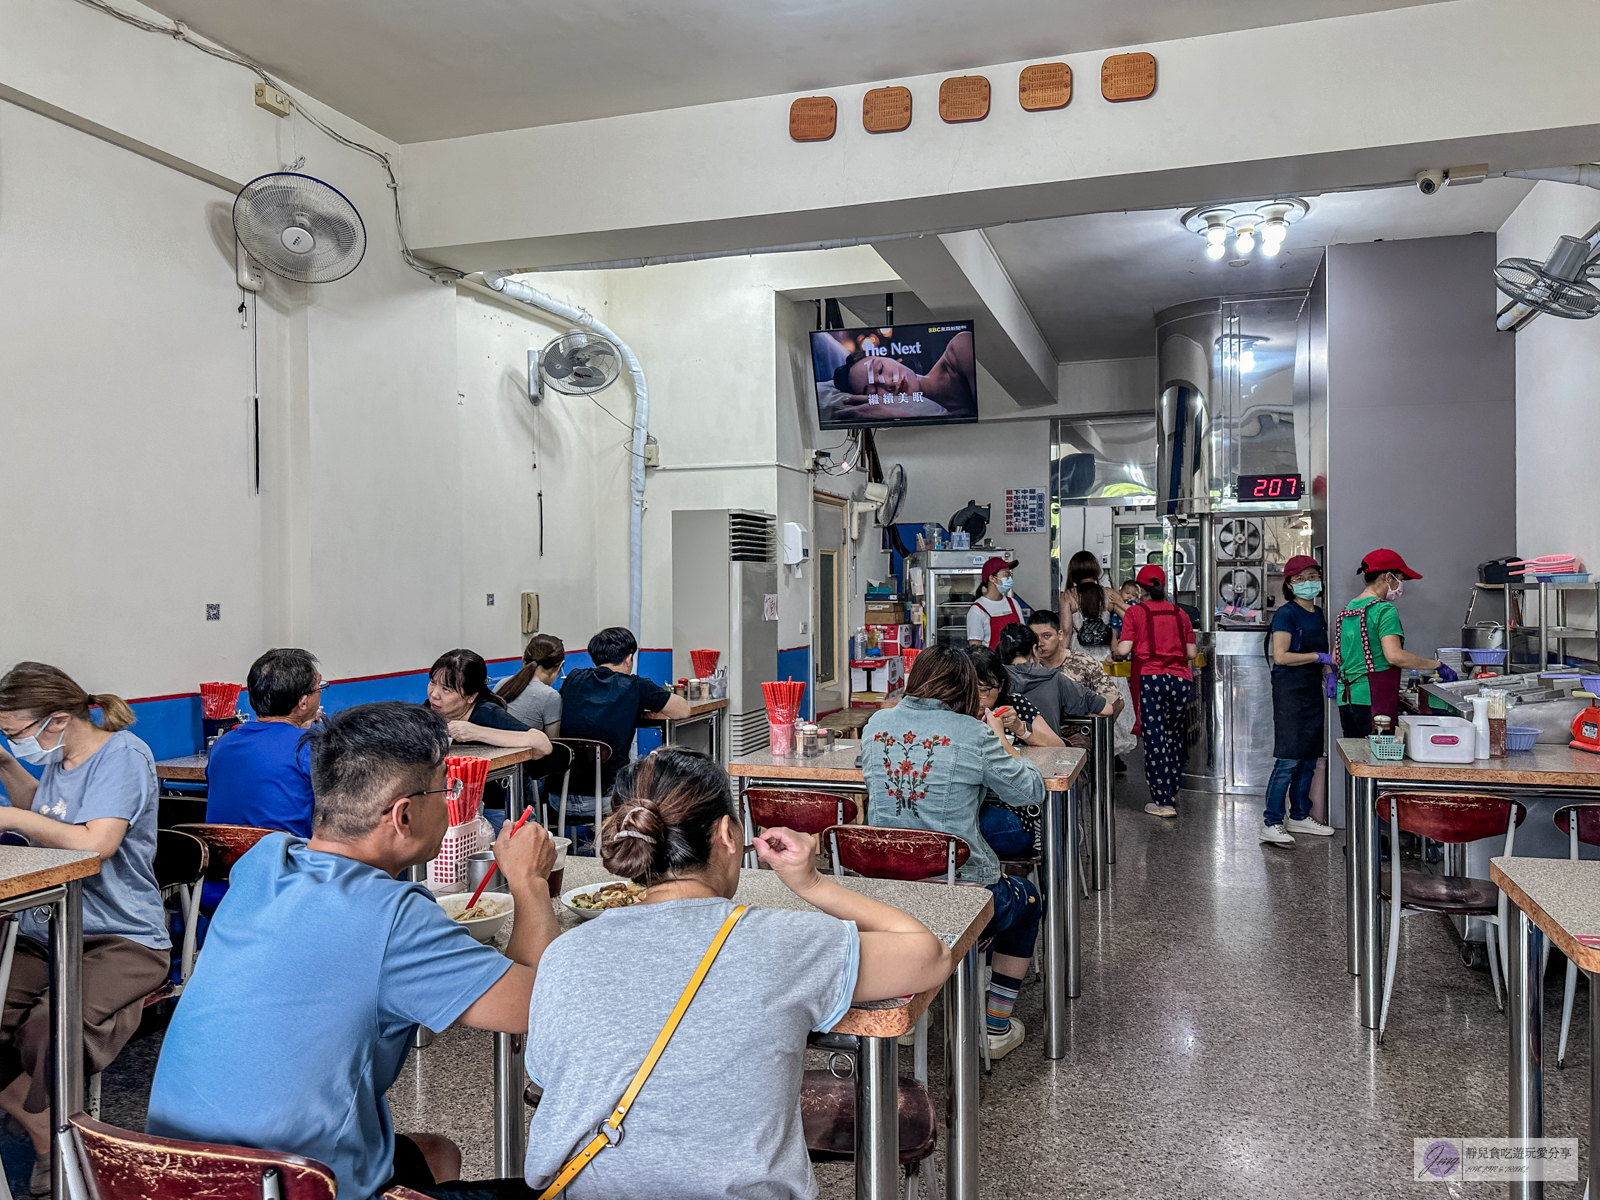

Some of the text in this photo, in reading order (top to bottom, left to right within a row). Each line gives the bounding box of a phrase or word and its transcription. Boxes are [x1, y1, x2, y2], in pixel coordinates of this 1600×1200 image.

[864, 342, 922, 357] The Next
[1253, 477, 1297, 497] 207
